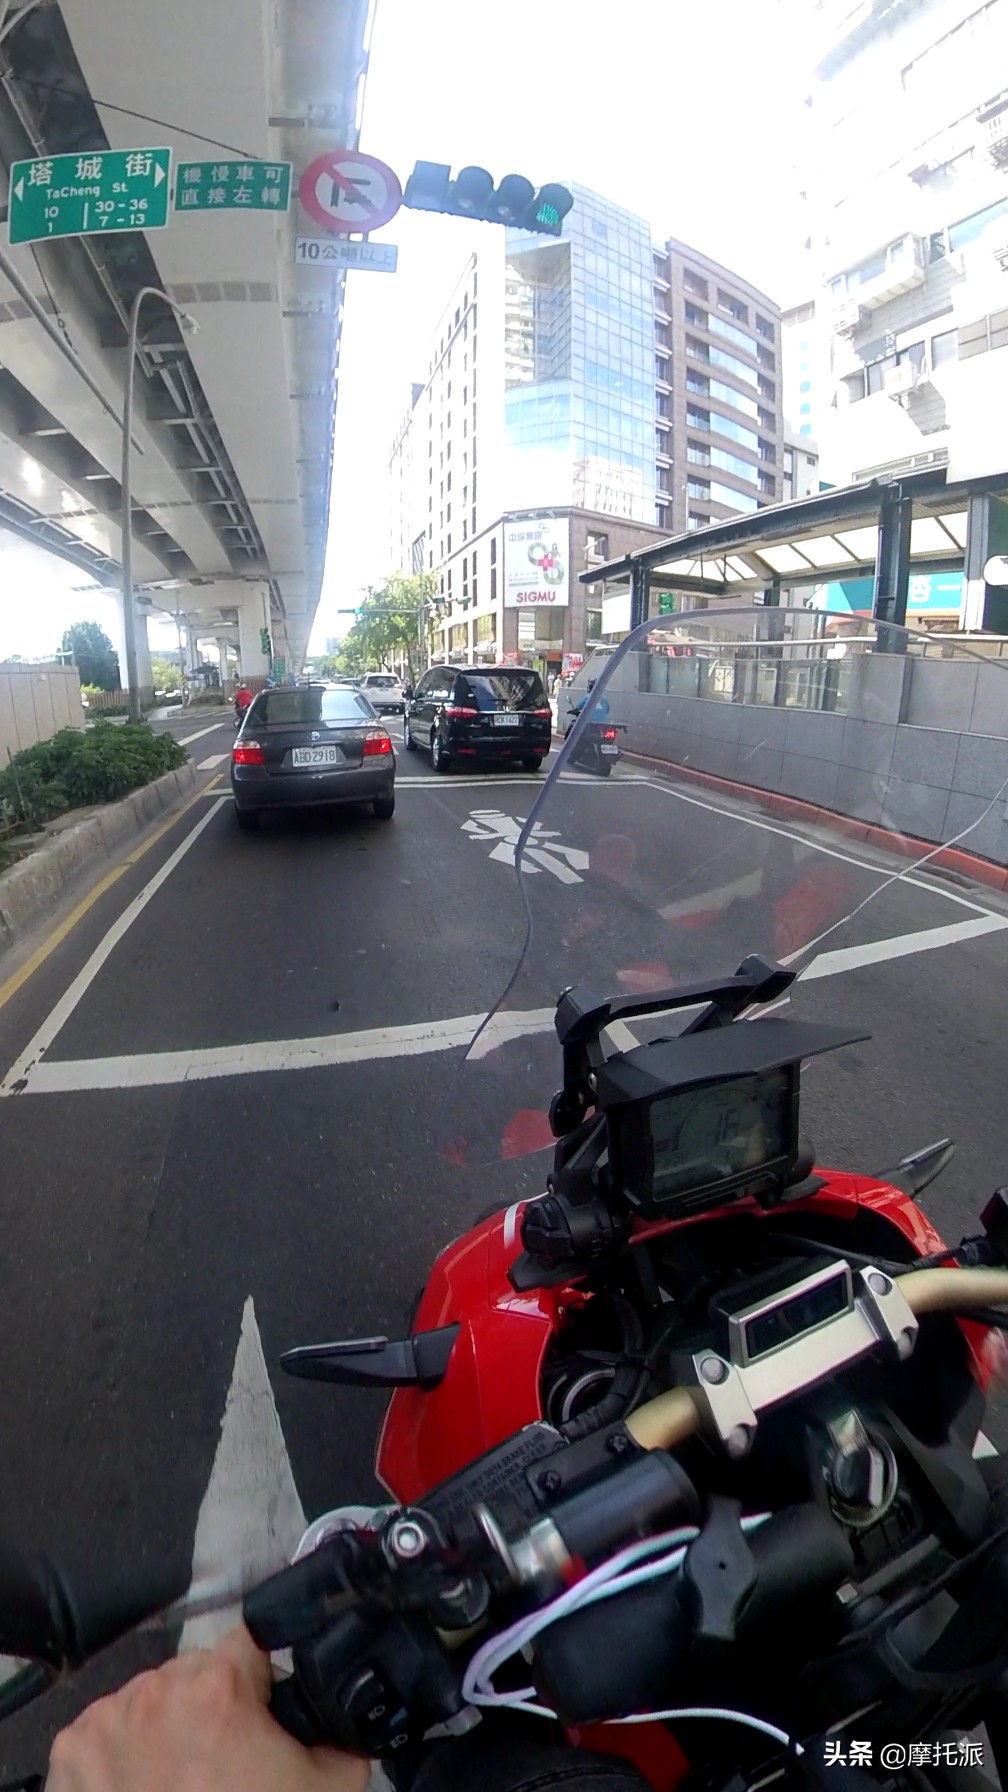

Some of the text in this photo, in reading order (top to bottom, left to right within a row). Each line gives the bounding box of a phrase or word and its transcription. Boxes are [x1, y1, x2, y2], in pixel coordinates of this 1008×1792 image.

[28, 153, 154, 187] 塔城街
[182, 165, 284, 184] 機慢車可
[46, 186, 100, 199] TaCheng
[181, 187, 282, 206] 直接左轉
[44, 206, 59, 219] 10
[48, 222, 53, 233] 1
[516, 591, 556, 603] SIGMU
